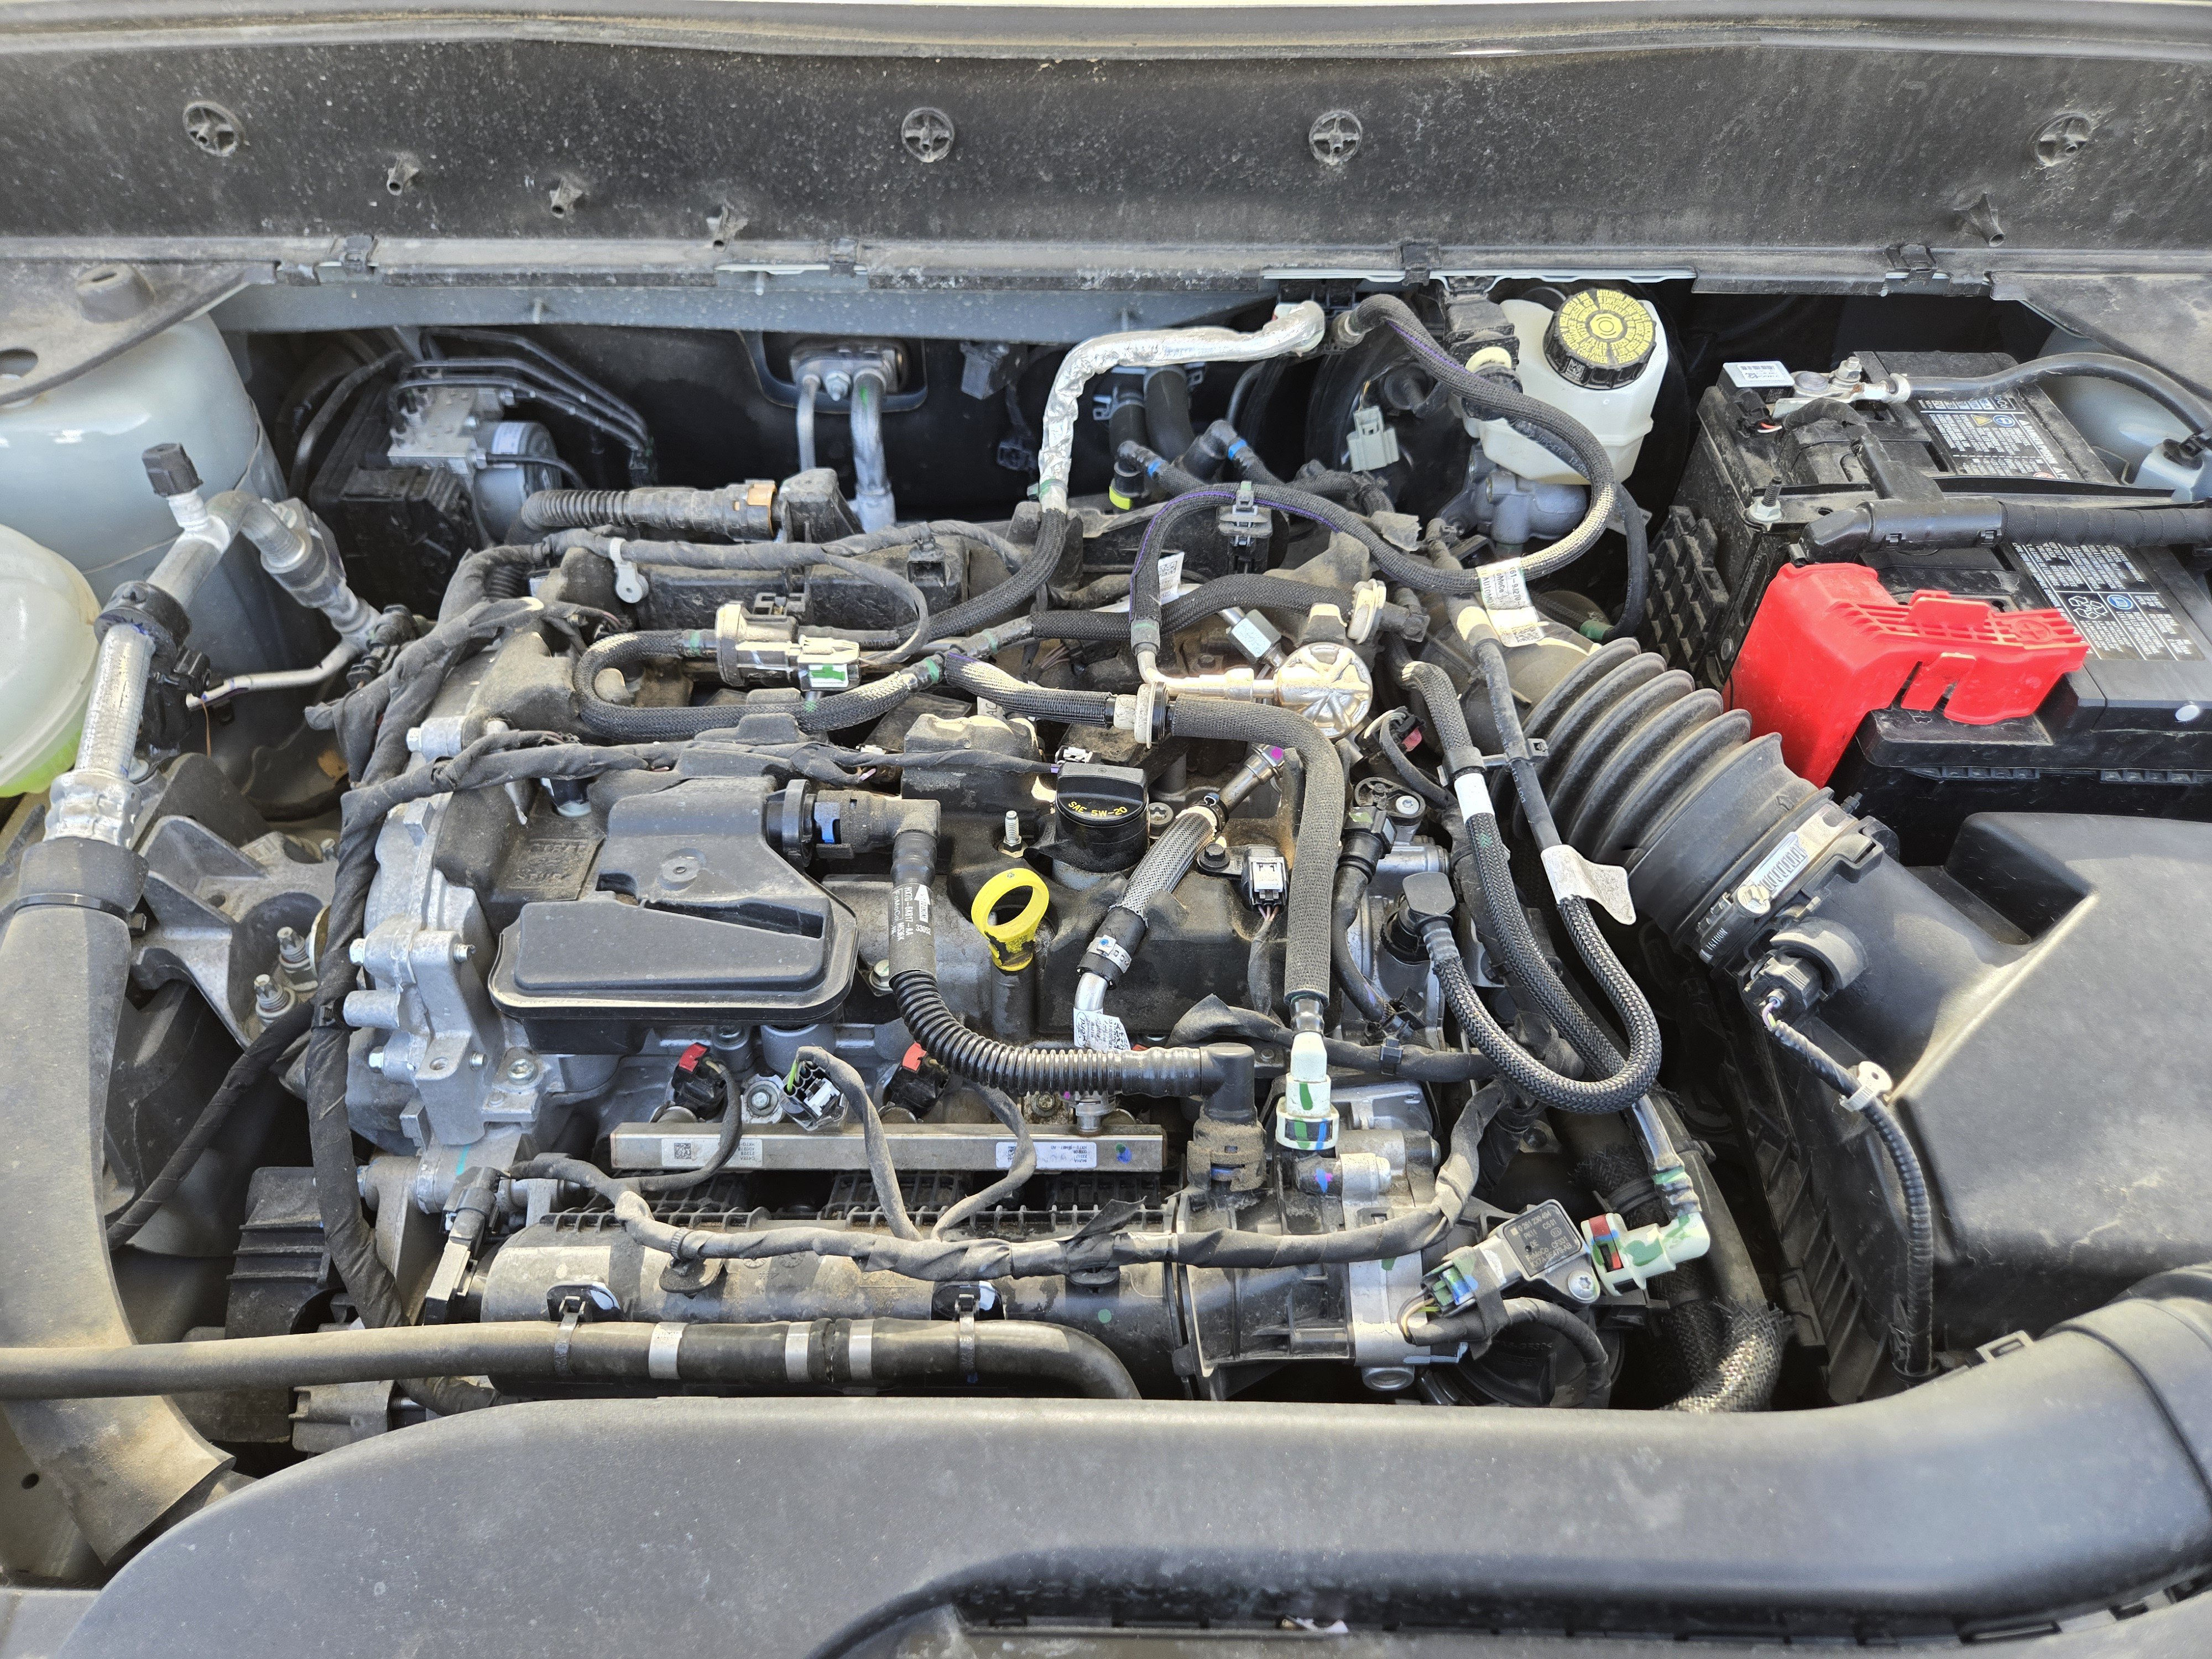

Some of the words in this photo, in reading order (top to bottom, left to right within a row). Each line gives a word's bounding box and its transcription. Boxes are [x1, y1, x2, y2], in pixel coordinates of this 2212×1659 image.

[2022, 426, 2058, 463] DANGER/POISON
[1068, 801, 1087, 816] SAE
[1091, 806, 1128, 818] 5W-20
[1706, 928, 1728, 953] TRIDON
[1077, 1018, 1087, 1041] Ford
[1525, 1248, 1548, 1262] FoMoCo
